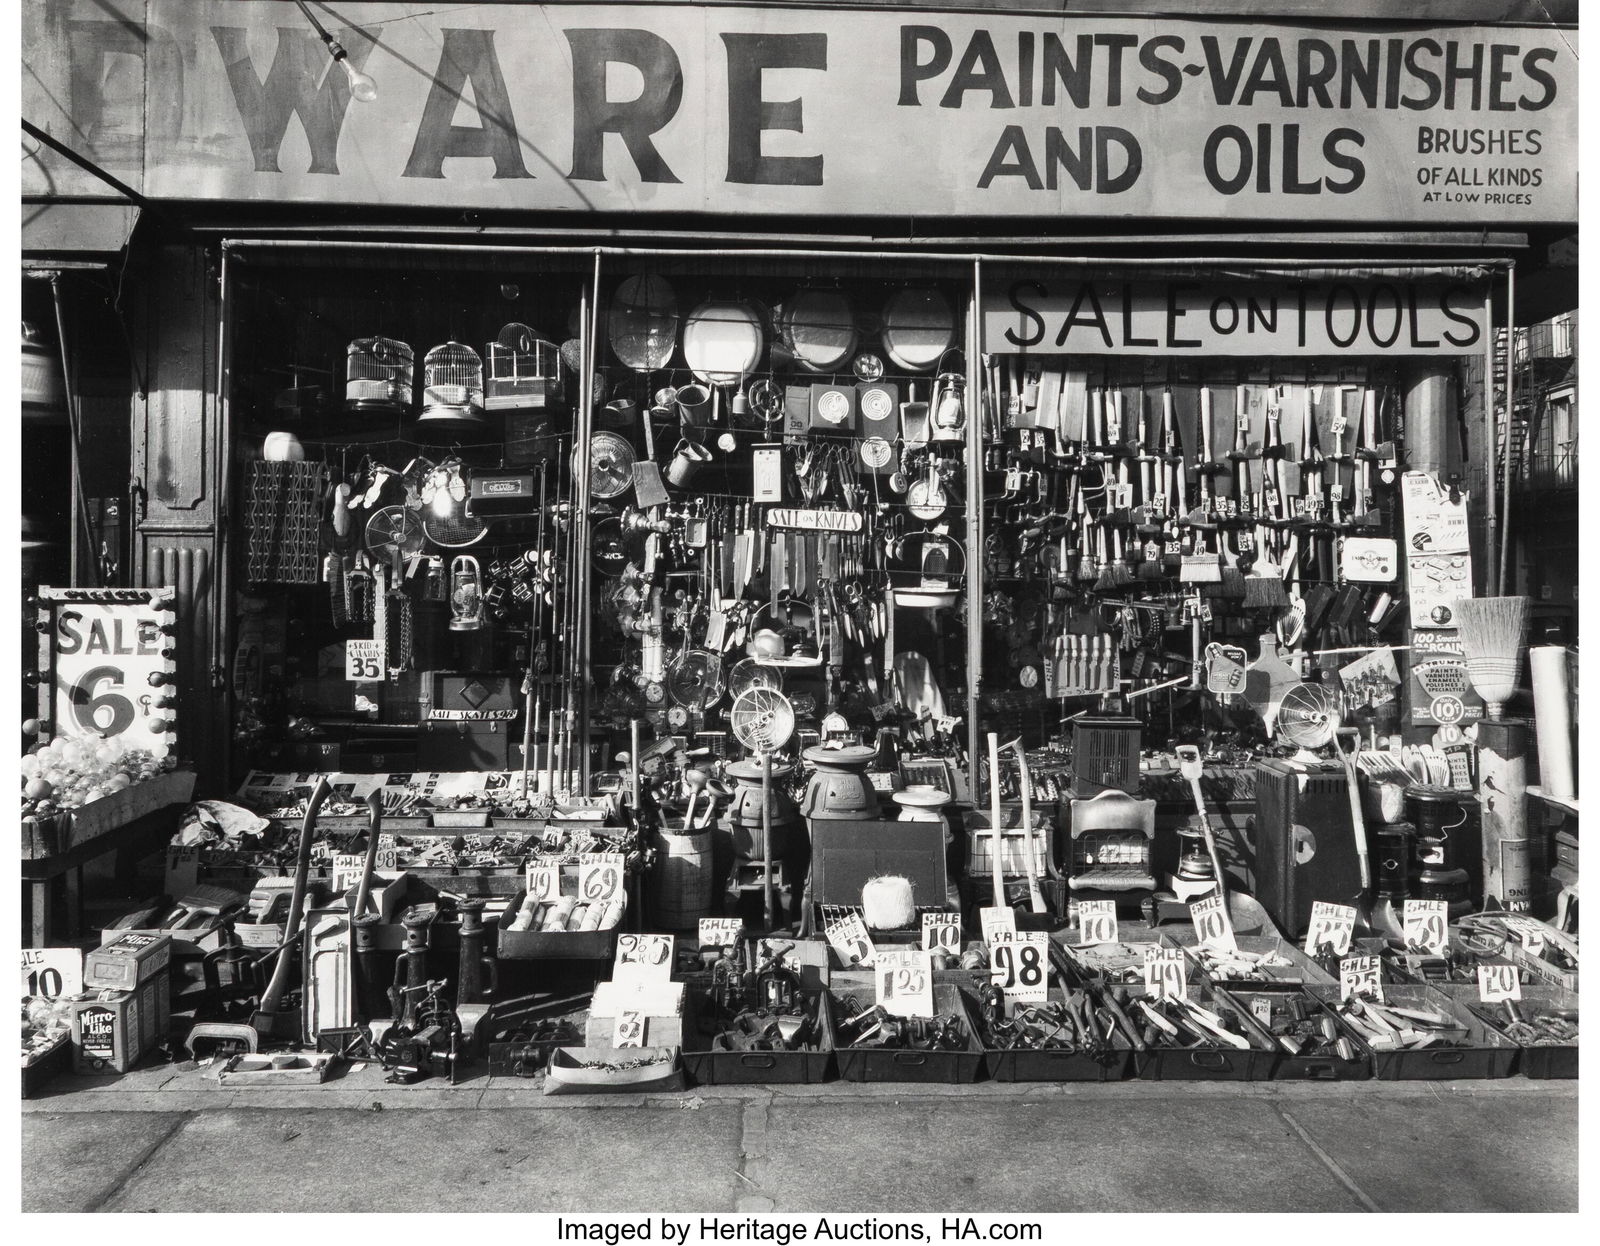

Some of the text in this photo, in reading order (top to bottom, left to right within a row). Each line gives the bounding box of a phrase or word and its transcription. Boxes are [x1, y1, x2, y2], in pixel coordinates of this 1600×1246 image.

[1417, 127, 1543, 156] BRUSHES
[977, 124, 1366, 195] AND OILS
[1417, 167, 1543, 188] OF ALL KINDS
[1423, 192, 1532, 205] AT LOW PRICES
[1004, 281, 1482, 348] SALE ON TOOLS
[1169, 543, 1180, 553] 35
[57, 610, 160, 656] SALE
[1412, 633, 1434, 643] 100
[354, 642, 371, 650] SKID
[352, 657, 380, 679] 35
[376, 850, 396, 869] 98
[580, 855, 621, 866] SALE
[583, 867, 618, 900] 69
[1079, 901, 1115, 915] SALE
[1191, 895, 1223, 915] SALE
[1314, 903, 1354, 919] SALE
[1408, 901, 1443, 912] SALE
[700, 919, 740, 931] SALE
[826, 912, 857, 936] SALE
[924, 913, 960, 926] SALE
[1199, 911, 1225, 945] 10
[929, 924, 960, 950] 10
[992, 931, 1034, 942] SALE
[1084, 916, 1116, 943] 10
[877, 950, 924, 967] SALE
[1145, 949, 1184, 963] SALE
[1341, 955, 1380, 973] SALE
[995, 945, 1043, 989] 98
[26, 967, 63, 998] 10
[1150, 962, 1183, 1000] 49
[80, 1010, 117, 1034] Mirro-
[89, 1022, 113, 1035] Like
